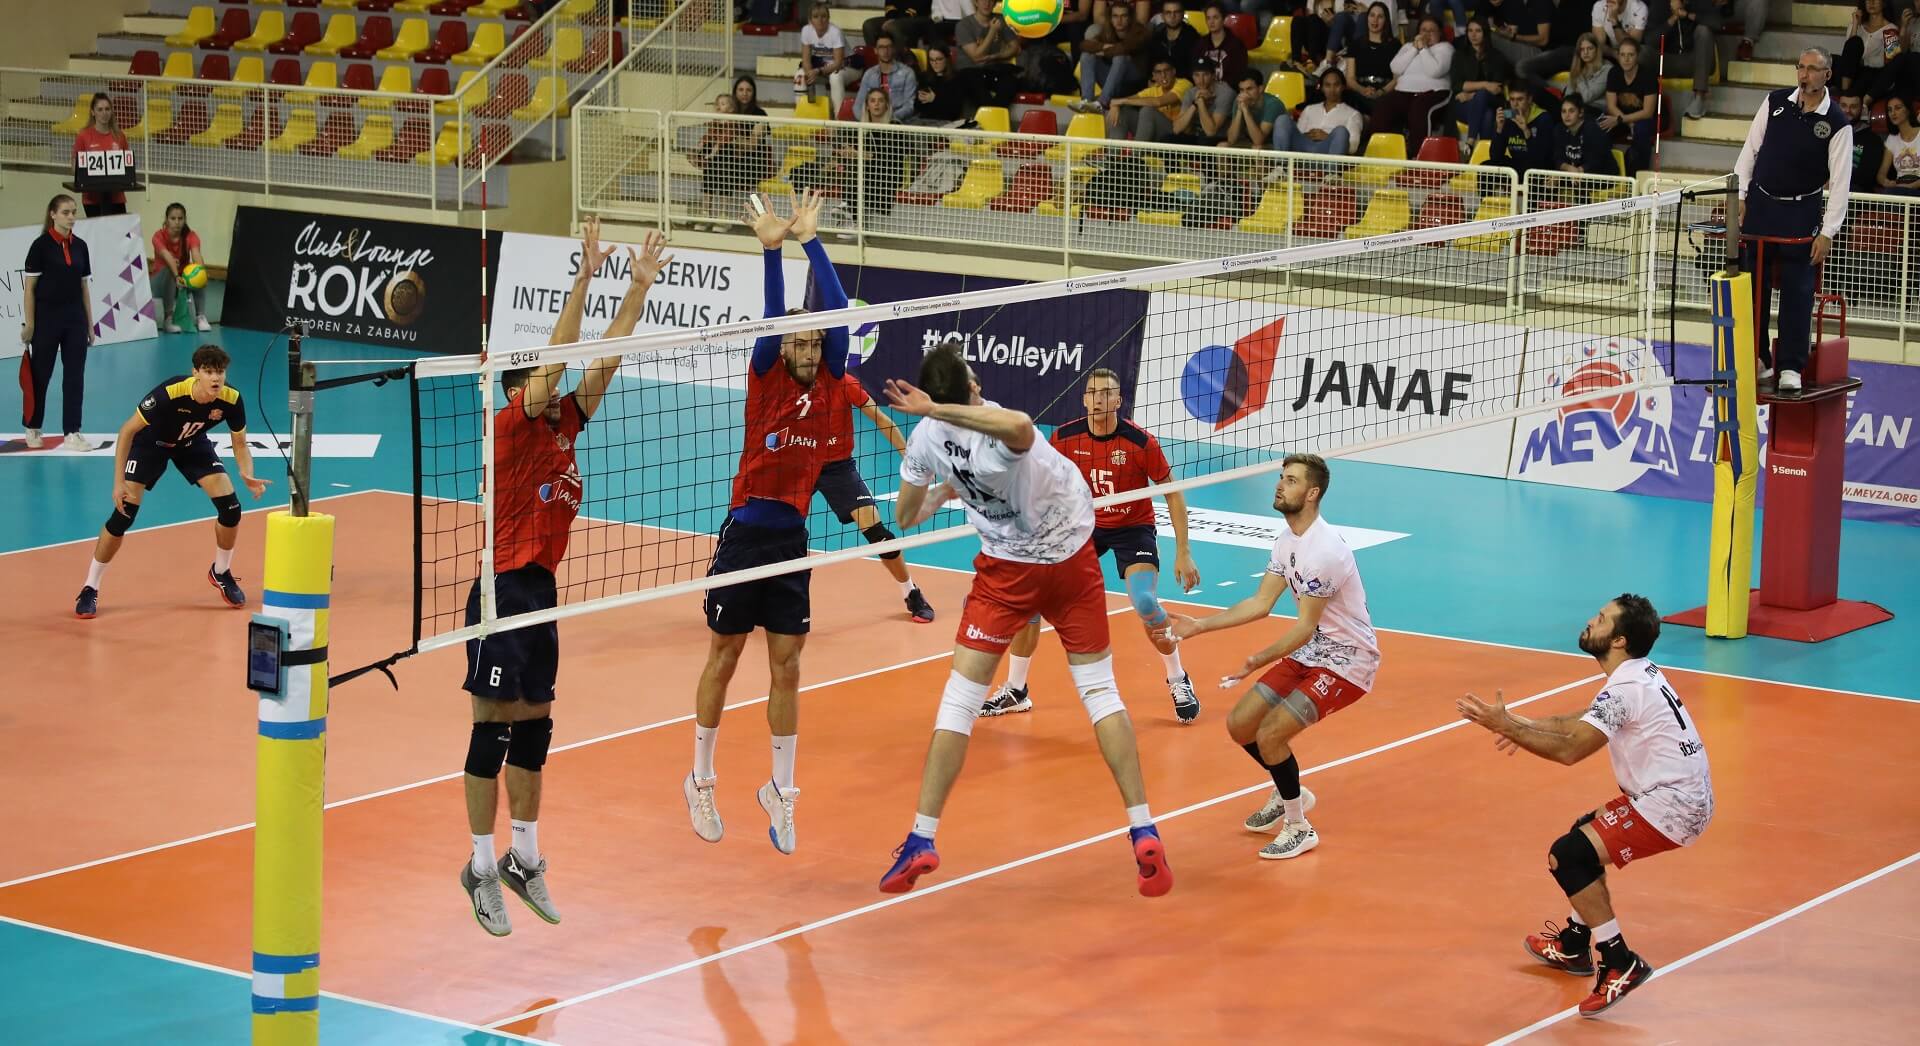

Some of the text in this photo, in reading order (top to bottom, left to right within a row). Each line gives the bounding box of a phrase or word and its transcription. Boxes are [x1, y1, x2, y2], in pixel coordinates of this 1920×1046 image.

[88, 156, 103, 170] 24
[108, 155, 122, 170] 17
[511, 285, 712, 329] INTENATNALIS
[346, 323, 361, 335] ZA
[367, 326, 418, 342] ZABAVU
[513, 321, 553, 335] proizvod
[522, 352, 540, 362] CEV
[1292, 357, 1473, 417] JANAF
[795, 393, 812, 417] 7
[1518, 394, 1676, 475] MEVZA
[125, 459, 137, 474] 10
[1778, 466, 1807, 477] Senoh
[1089, 468, 1115, 497] 15
[715, 604, 723, 621] 7
[489, 666, 502, 687] 6
